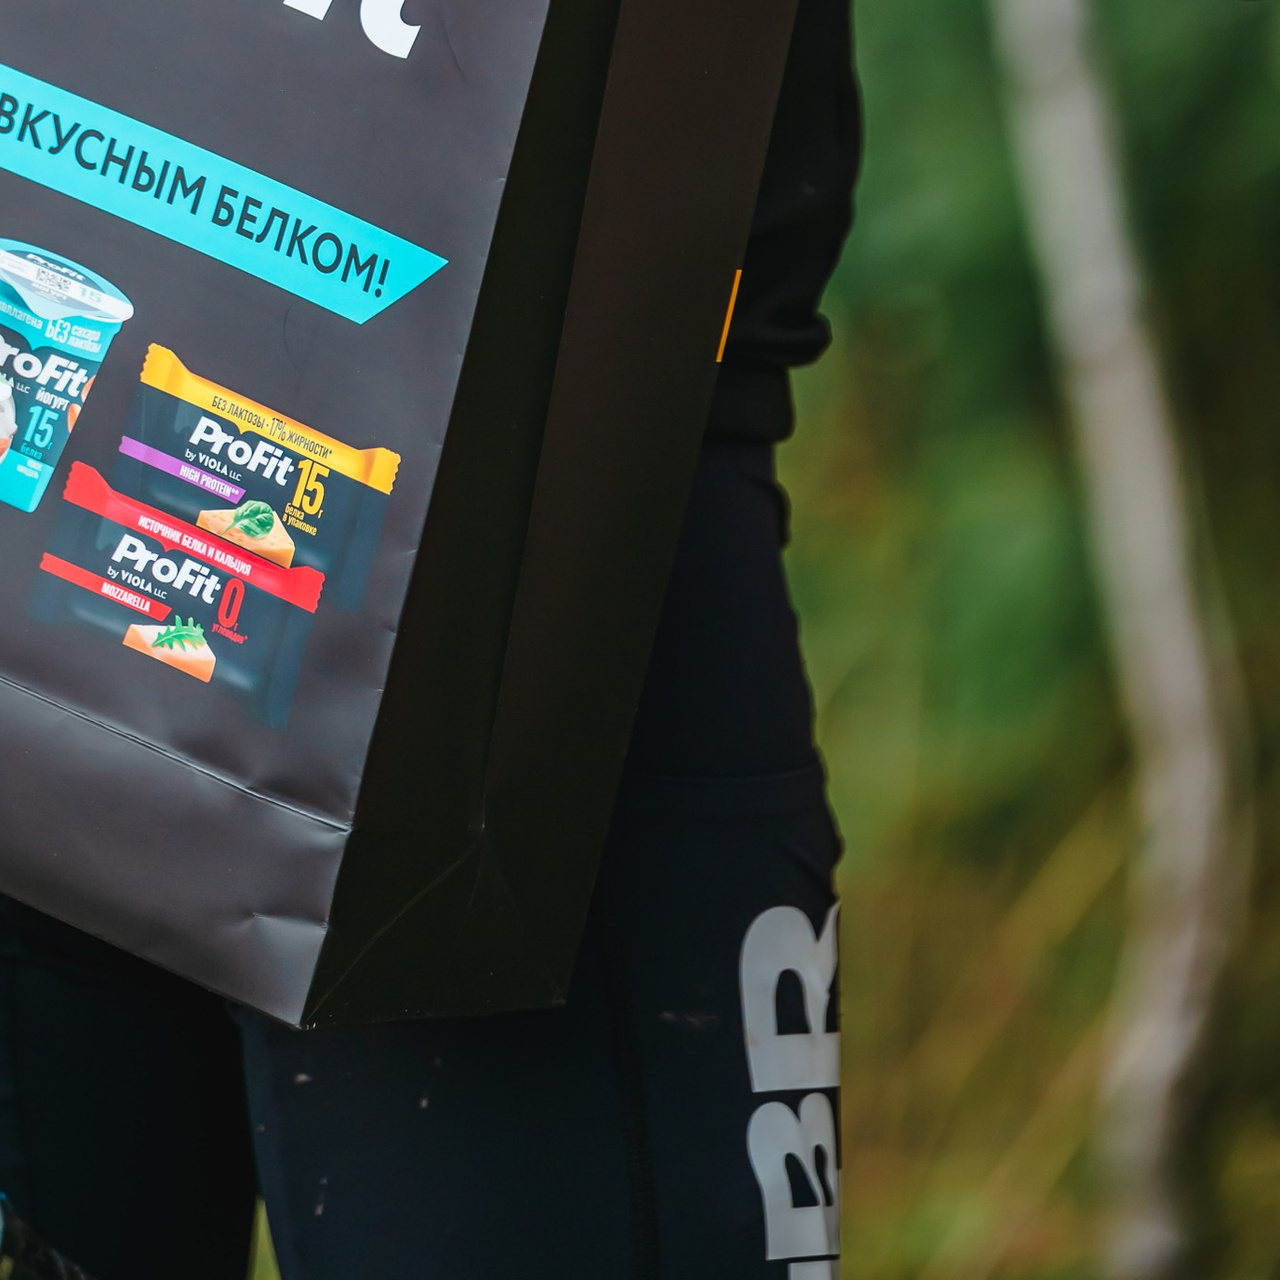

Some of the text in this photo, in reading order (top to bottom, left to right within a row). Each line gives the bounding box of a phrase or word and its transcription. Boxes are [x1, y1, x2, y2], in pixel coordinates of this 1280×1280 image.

[213, 188, 392, 301] БЕЛКОМ!
[24, 405, 60, 448] 15
[212, 395, 227, 411] БЕЗ
[228, 403, 265, 429] ЛАКТОЗЫ
[185, 449, 243, 482] by VIOLA LLC
[189, 416, 295, 487] ProFit
[179, 464, 201, 483] HIGH
[292, 459, 330, 515] 15
[285, 503, 305, 519] белка
[138, 515, 182, 543] ИСТОЧНИК
[182, 534, 208, 556] БЕЛКА
[214, 550, 252, 577] КАЛЬЦИЯ
[107, 566, 168, 600] by VIOLA LLC
[111, 534, 221, 604] ProFit
[101, 582, 151, 613] MOZZARELLA
[738, 901, 841, 1280] BR
